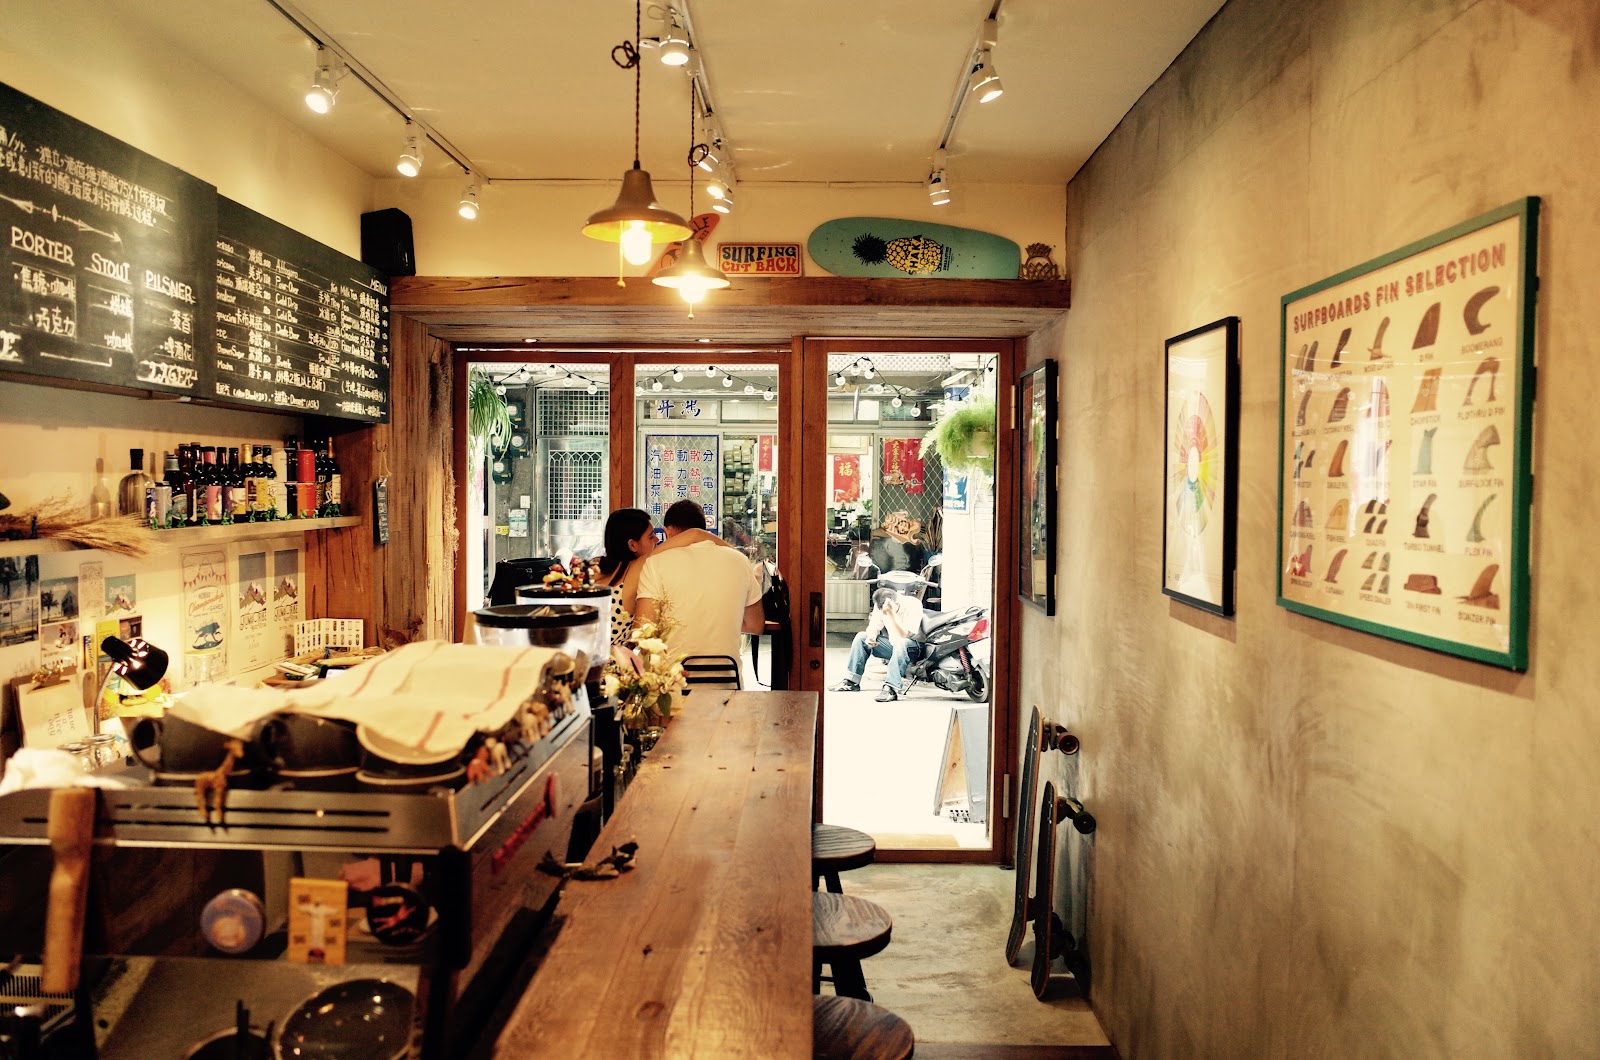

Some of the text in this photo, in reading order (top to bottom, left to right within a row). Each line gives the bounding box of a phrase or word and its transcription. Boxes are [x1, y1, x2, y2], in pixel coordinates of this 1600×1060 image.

[11, 226, 75, 266] PORTER
[722, 246, 797, 263] SURFING
[908, 234, 922, 275] SHAKA
[92, 253, 130, 281] STOUT
[721, 257, 797, 272] CUT BACK
[145, 270, 194, 303] PILSNER
[370, 279, 387, 296] MENU
[1293, 244, 1506, 334] SURFBOARDS FIN SELECTION
[1461, 336, 1503, 354] BOOMERANG
[650, 449, 661, 515] 汽油泵浦
[838, 461, 853, 476] 福
